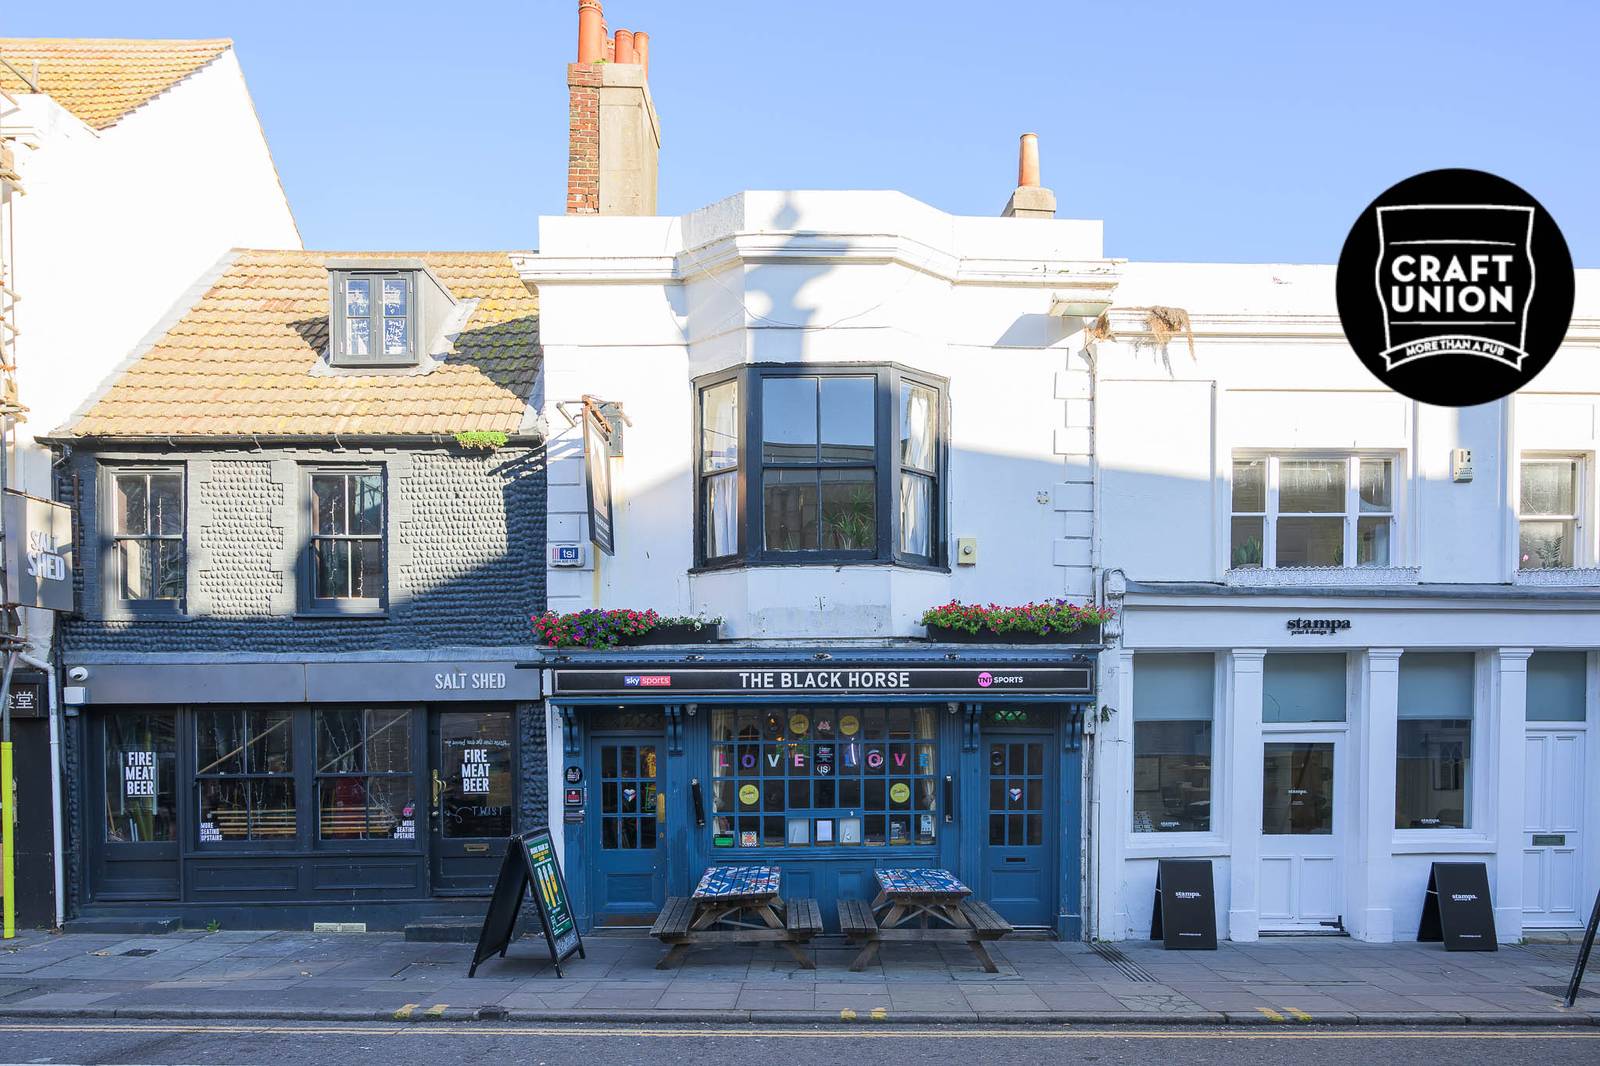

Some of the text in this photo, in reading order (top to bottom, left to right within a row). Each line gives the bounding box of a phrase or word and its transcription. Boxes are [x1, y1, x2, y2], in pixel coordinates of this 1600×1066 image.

[31, 530, 58, 555] SALT
[27, 551, 66, 581] SHED
[1287, 617, 1352, 633] stampa
[435, 673, 506, 689] SALT SHED
[626, 676, 670, 685] sky sports
[739, 672, 910, 688] THE BLACK HORSE
[128, 751, 152, 766] FIRE
[463, 749, 488, 763] FIRE
[125, 766, 155, 780] MEAT
[461, 763, 491, 778] MEAT
[126, 780, 154, 795] BEER
[463, 778, 490, 792] BEER
